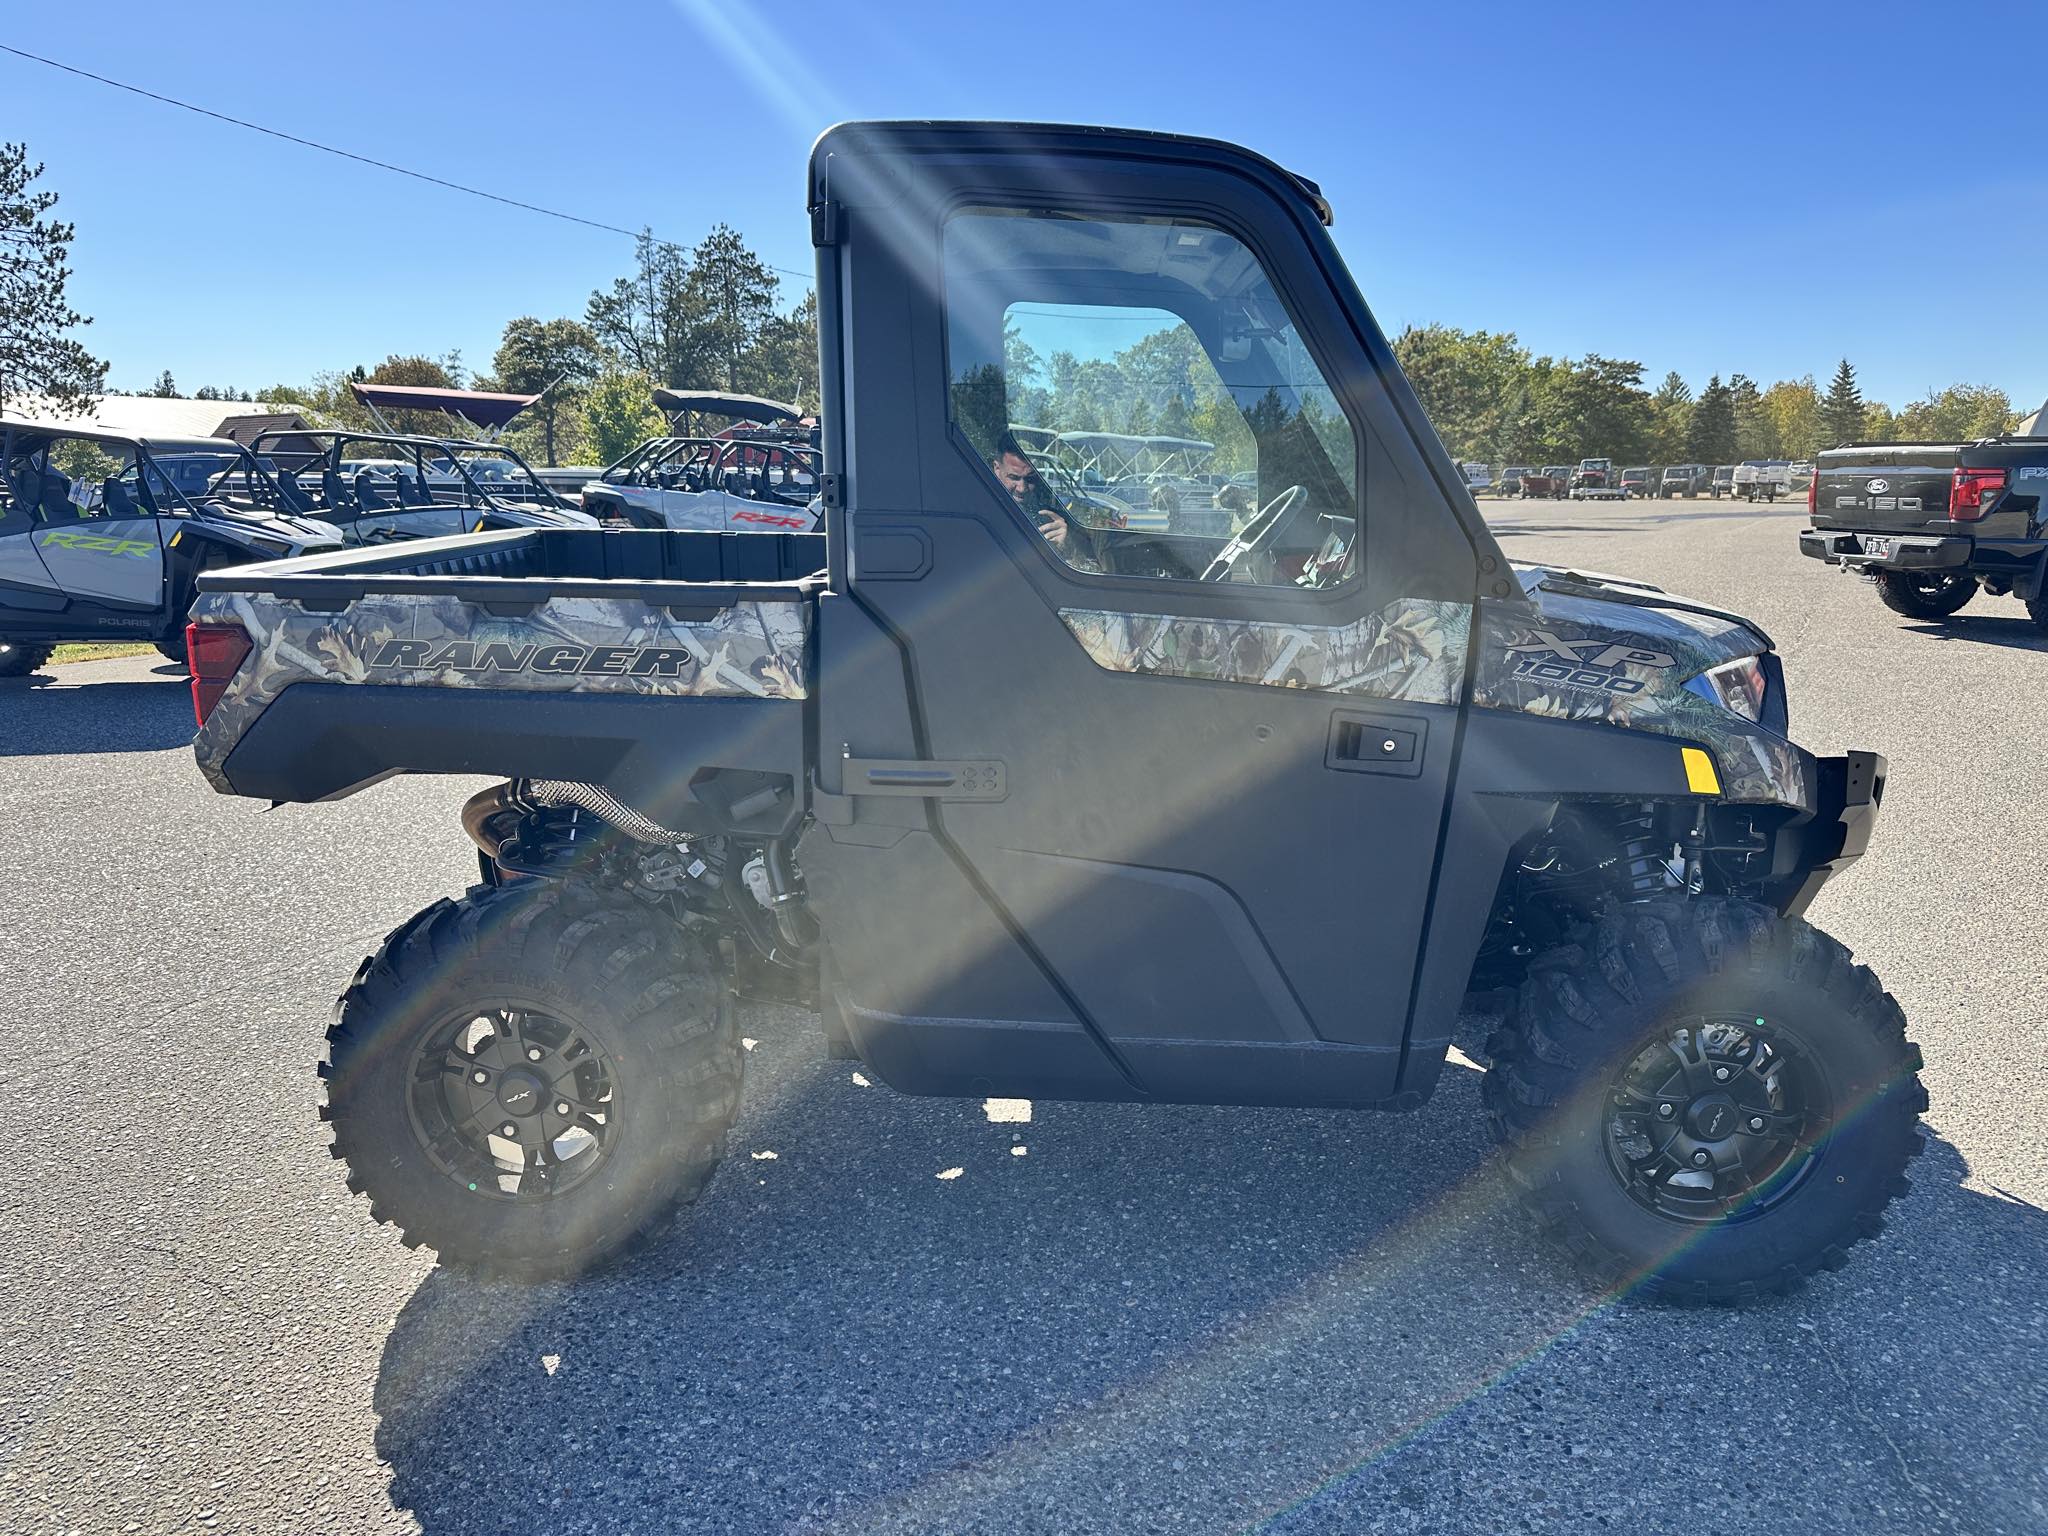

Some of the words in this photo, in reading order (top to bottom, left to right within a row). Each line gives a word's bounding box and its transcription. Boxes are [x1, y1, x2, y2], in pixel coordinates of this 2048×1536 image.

[1835, 496, 1923, 511] F-150
[730, 511, 807, 529] RZR
[40, 532, 155, 559] RZR
[98, 617, 151, 627] POLARIS
[369, 638, 691, 677] RANGER
[1504, 629, 1678, 669] XP
[1511, 675, 1542, 685] DUAL
[1544, 681, 1609, 696] OVERHEAD
[1512, 660, 1647, 696] 1000
